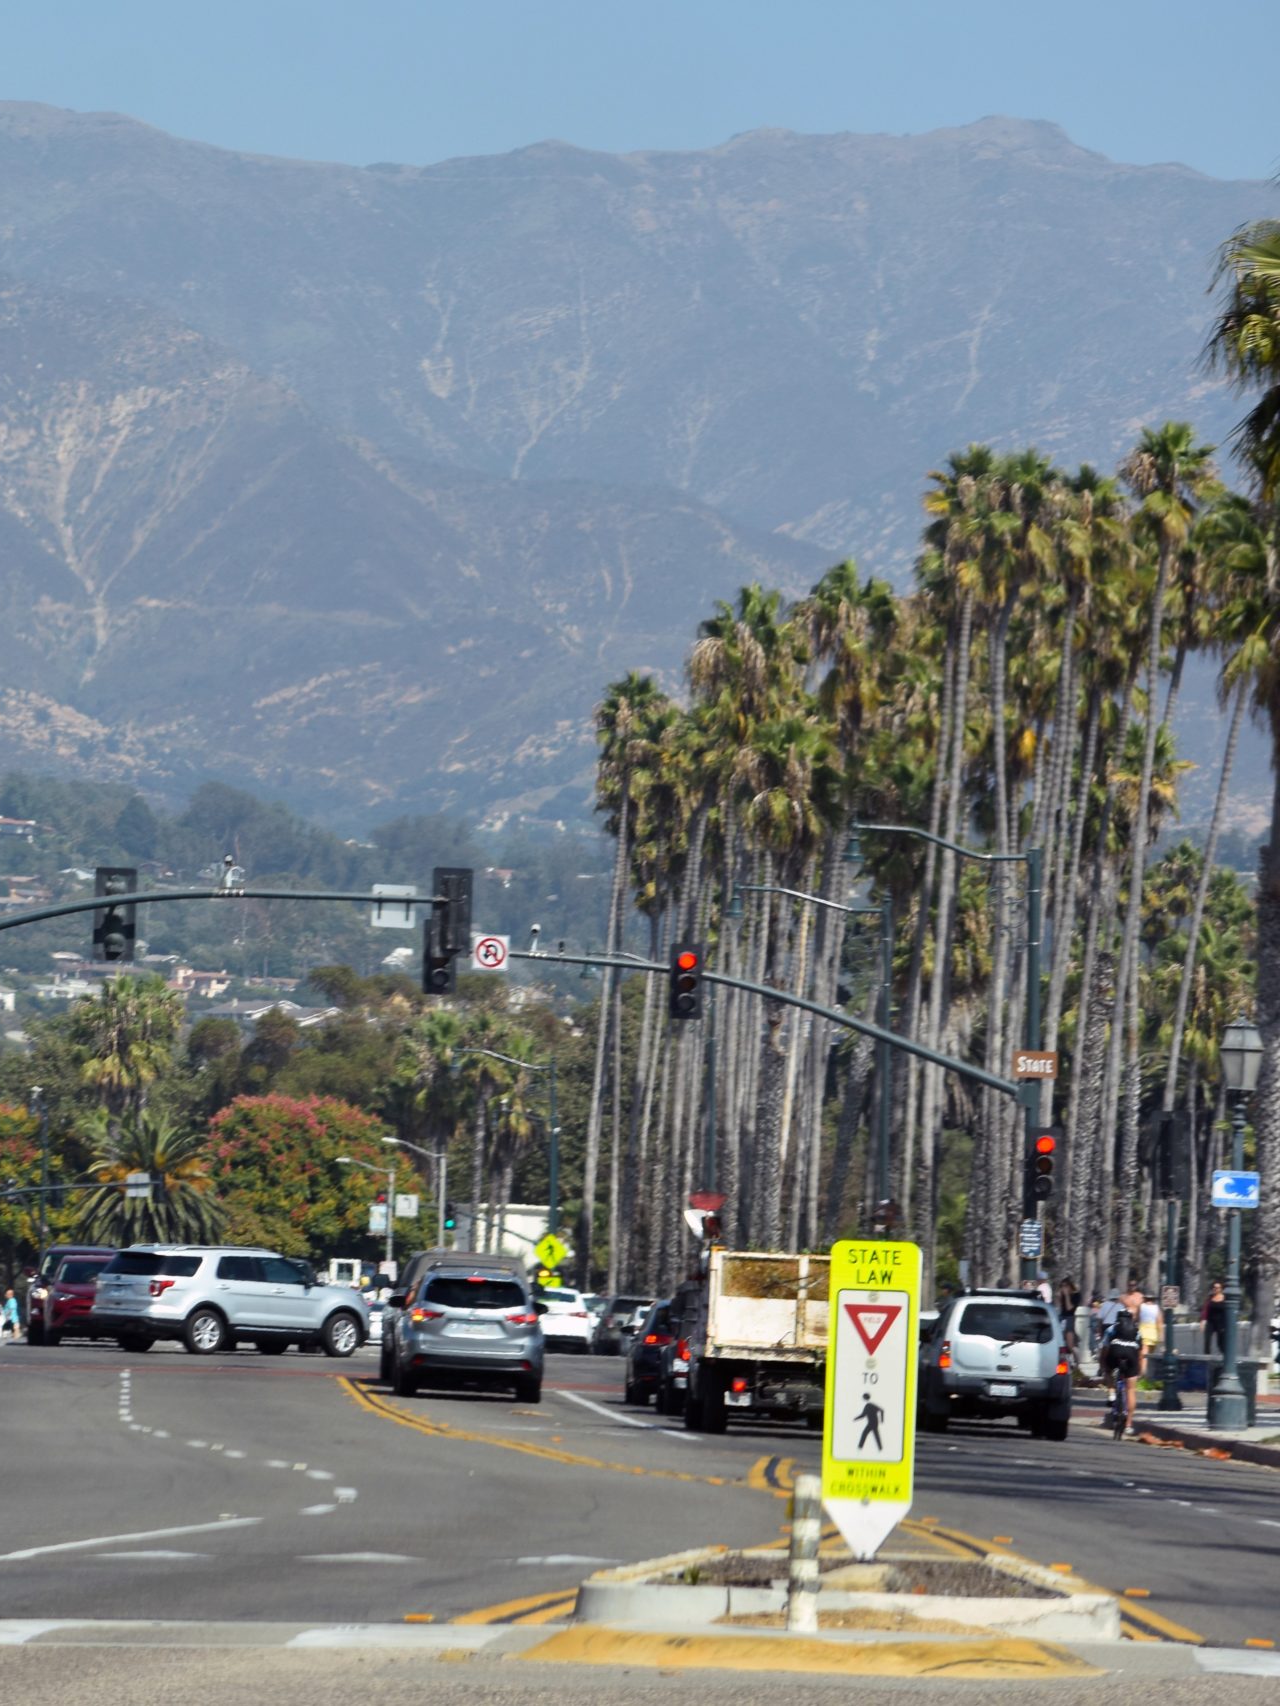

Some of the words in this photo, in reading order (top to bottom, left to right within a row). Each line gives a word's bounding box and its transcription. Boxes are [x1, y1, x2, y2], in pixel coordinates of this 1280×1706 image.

[1016, 1056, 1054, 1073] STATE
[848, 1249, 902, 1266] STATE
[856, 1269, 893, 1285] LAW
[862, 1372, 879, 1385] TO
[847, 1468, 887, 1479] WITHIN
[830, 1481, 901, 1495] CROSSWALK
